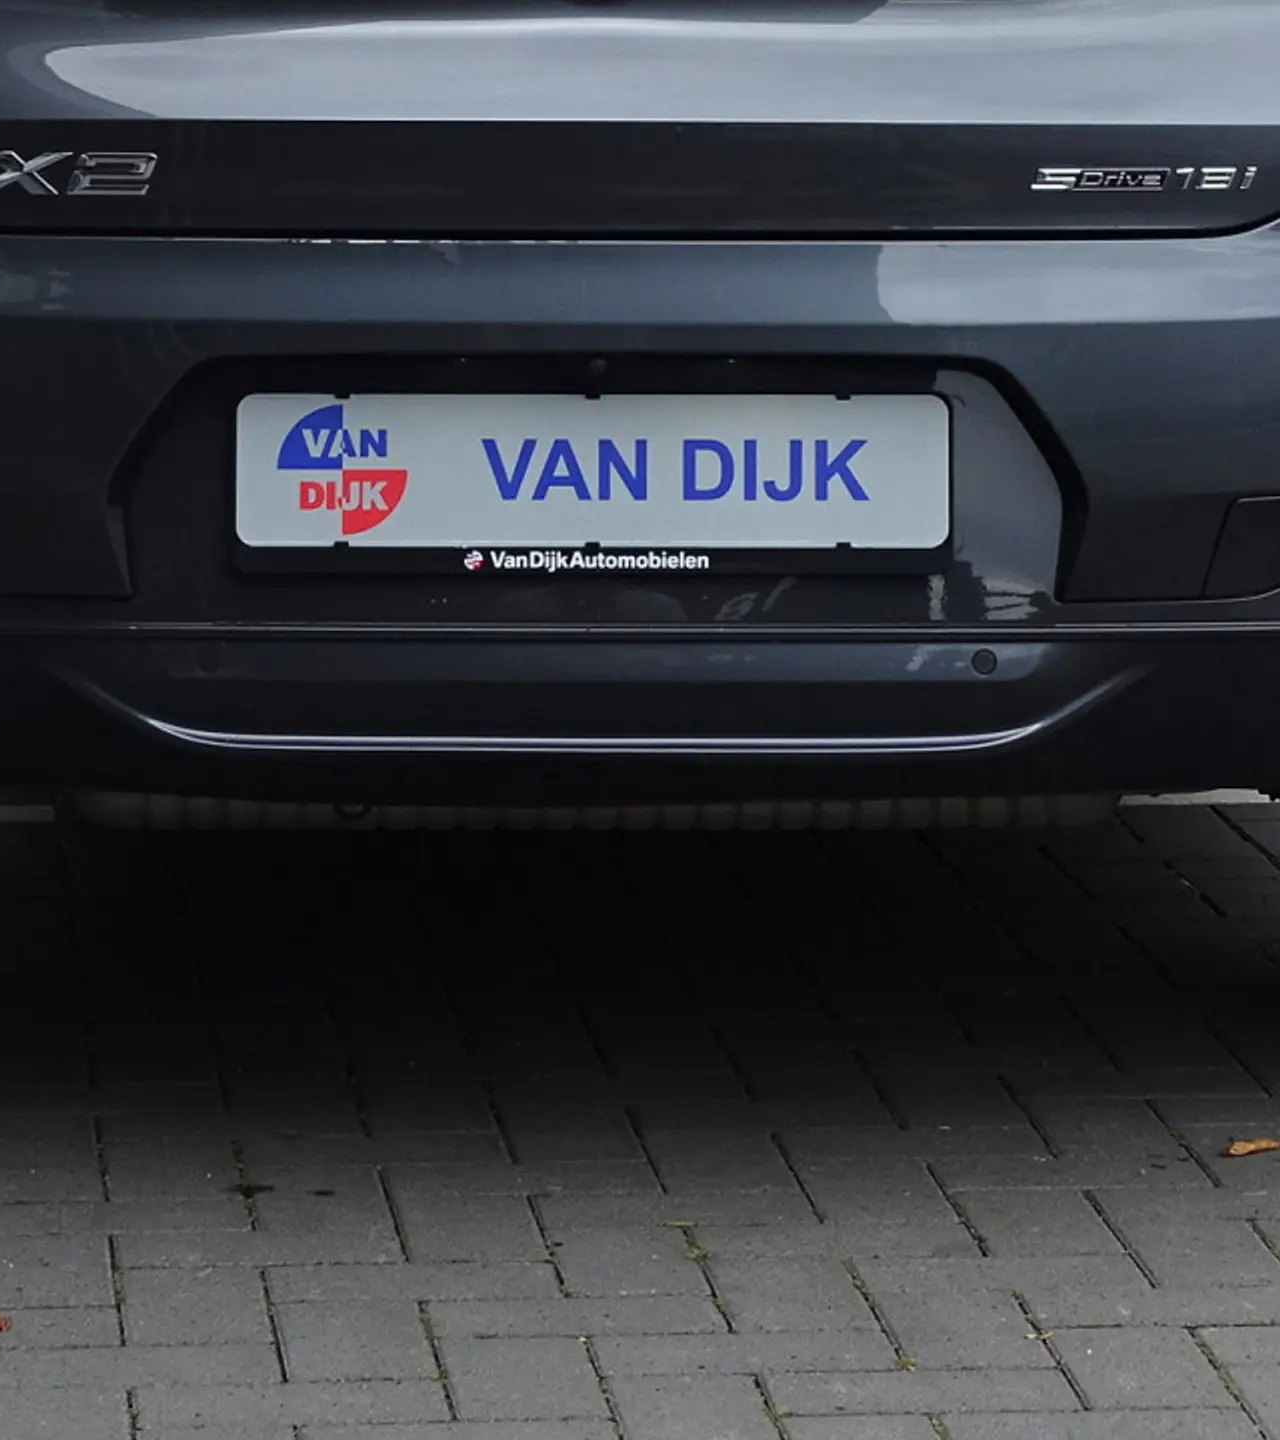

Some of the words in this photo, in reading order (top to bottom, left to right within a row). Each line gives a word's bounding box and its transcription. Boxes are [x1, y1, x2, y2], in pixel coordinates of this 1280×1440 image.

[301, 428, 388, 458] VAN
[481, 438, 648, 501] VAN
[682, 438, 870, 502] DIJK
[299, 481, 389, 511] DIJK
